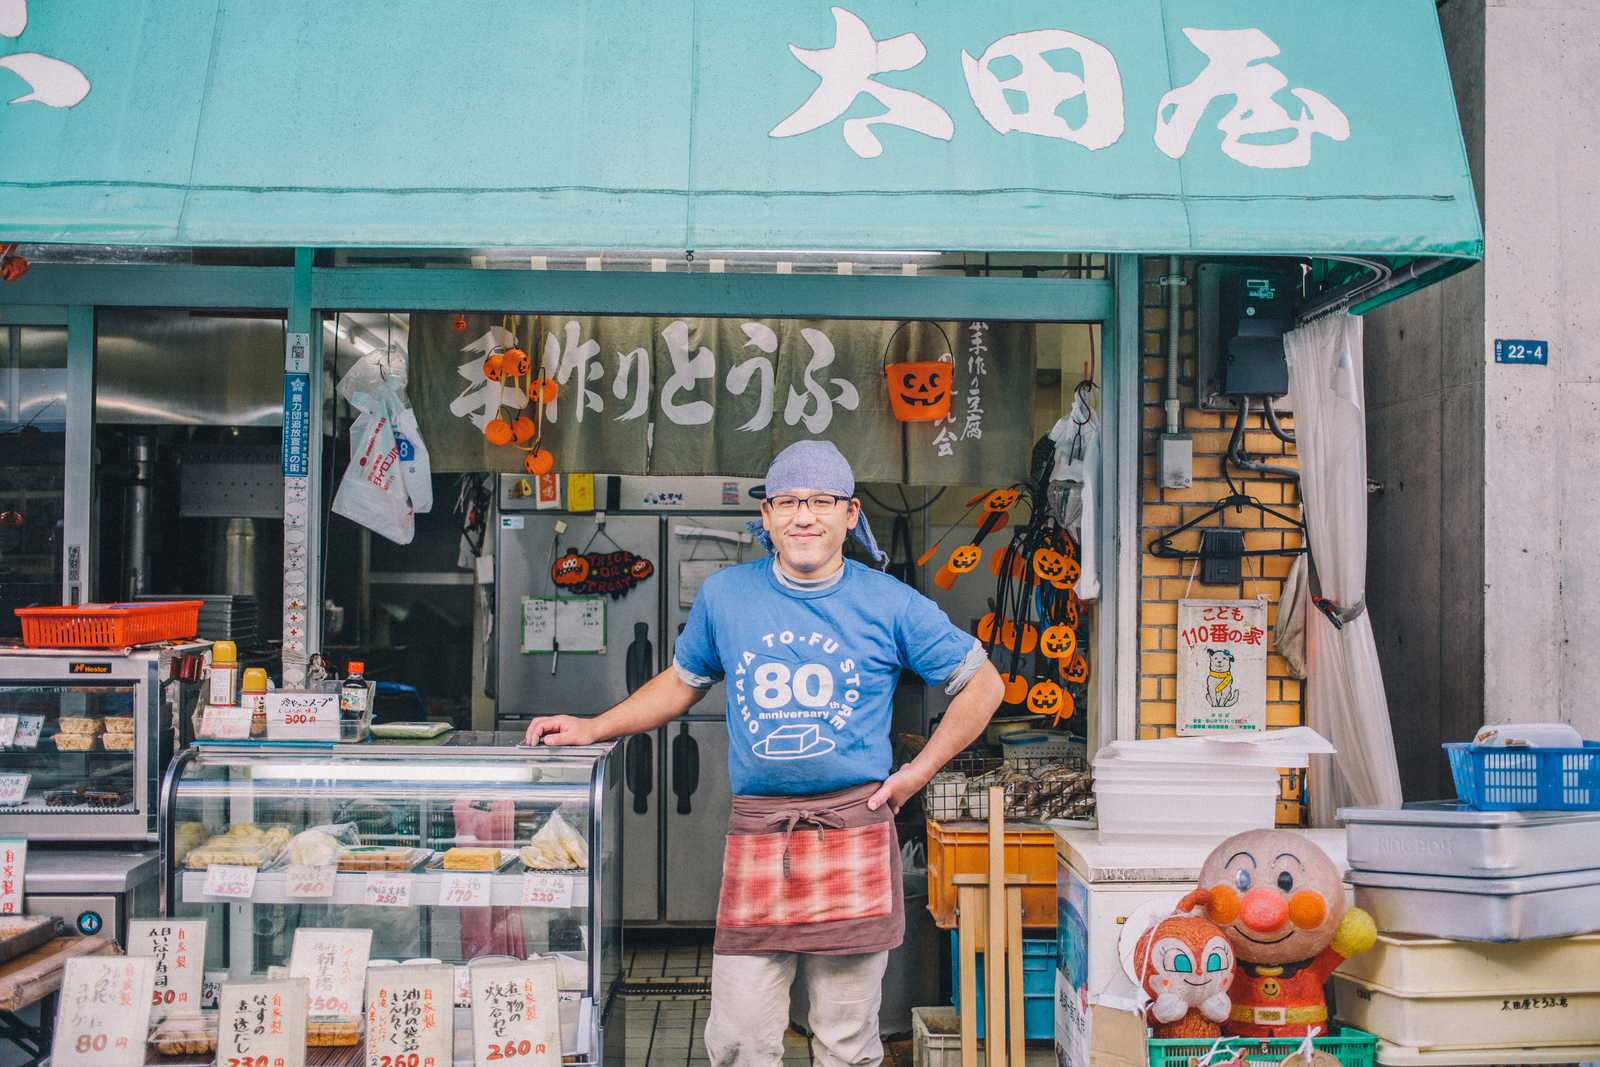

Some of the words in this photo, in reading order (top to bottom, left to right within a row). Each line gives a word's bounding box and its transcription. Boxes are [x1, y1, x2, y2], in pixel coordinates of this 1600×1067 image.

[768, 6, 1350, 169] 太田屋
[1508, 345, 1543, 359] 22-4
[449, 320, 860, 434] 手作りとうふ
[289, 393, 302, 472] 暴力団追放宣言の街
[586, 552, 632, 567] TRICK
[600, 566, 620, 578] OR
[585, 576, 631, 592] TREAT
[1182, 624, 1264, 646] 110番の家
[1203, 606, 1244, 622] こども
[281, 697, 333, 708] 冷やっこスープ
[735, 651, 759, 734] OHTAYA
[762, 630, 839, 654] TO-FU
[829, 658, 860, 731] STORE
[752, 662, 834, 709] 80
[829, 701, 840, 709] th
[758, 710, 830, 720] anniversary
[0, 849, 17, 899] 自家製
[175, 927, 187, 970] 自家製
[118, 962, 134, 1006] 自家製
[504, 981, 524, 1022] 煮物の
[524, 977, 539, 1022] 自家製
[1501, 996, 1569, 1012] 太田屋とうふ店
[253, 994, 268, 1035] なすの
[267, 993, 285, 1036] 自家製
[422, 987, 438, 1032] 自家製
[484, 981, 508, 1038] 炊き合わせ
